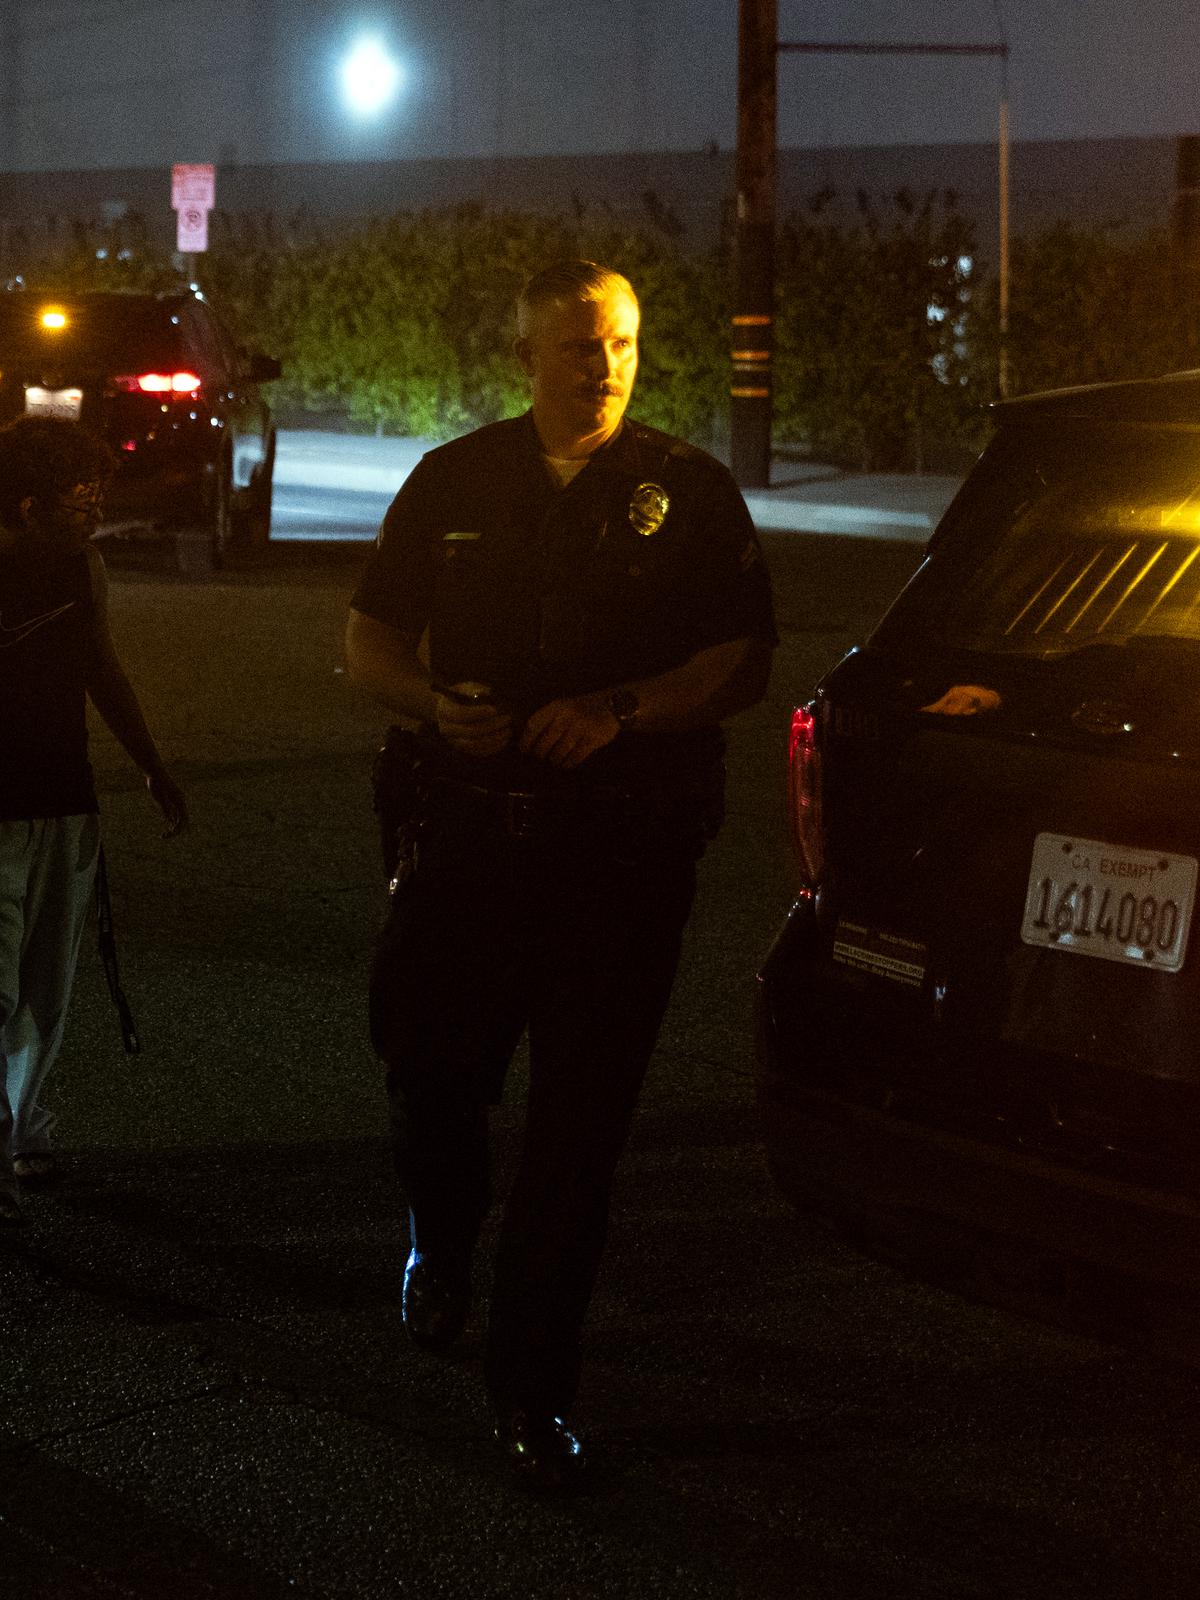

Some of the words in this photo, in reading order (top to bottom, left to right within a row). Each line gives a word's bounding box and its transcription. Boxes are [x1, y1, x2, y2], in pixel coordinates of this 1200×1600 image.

[1071, 854, 1091, 871] CA
[1100, 858, 1157, 880] EXEMPT
[1033, 877, 1178, 950] 1614080
